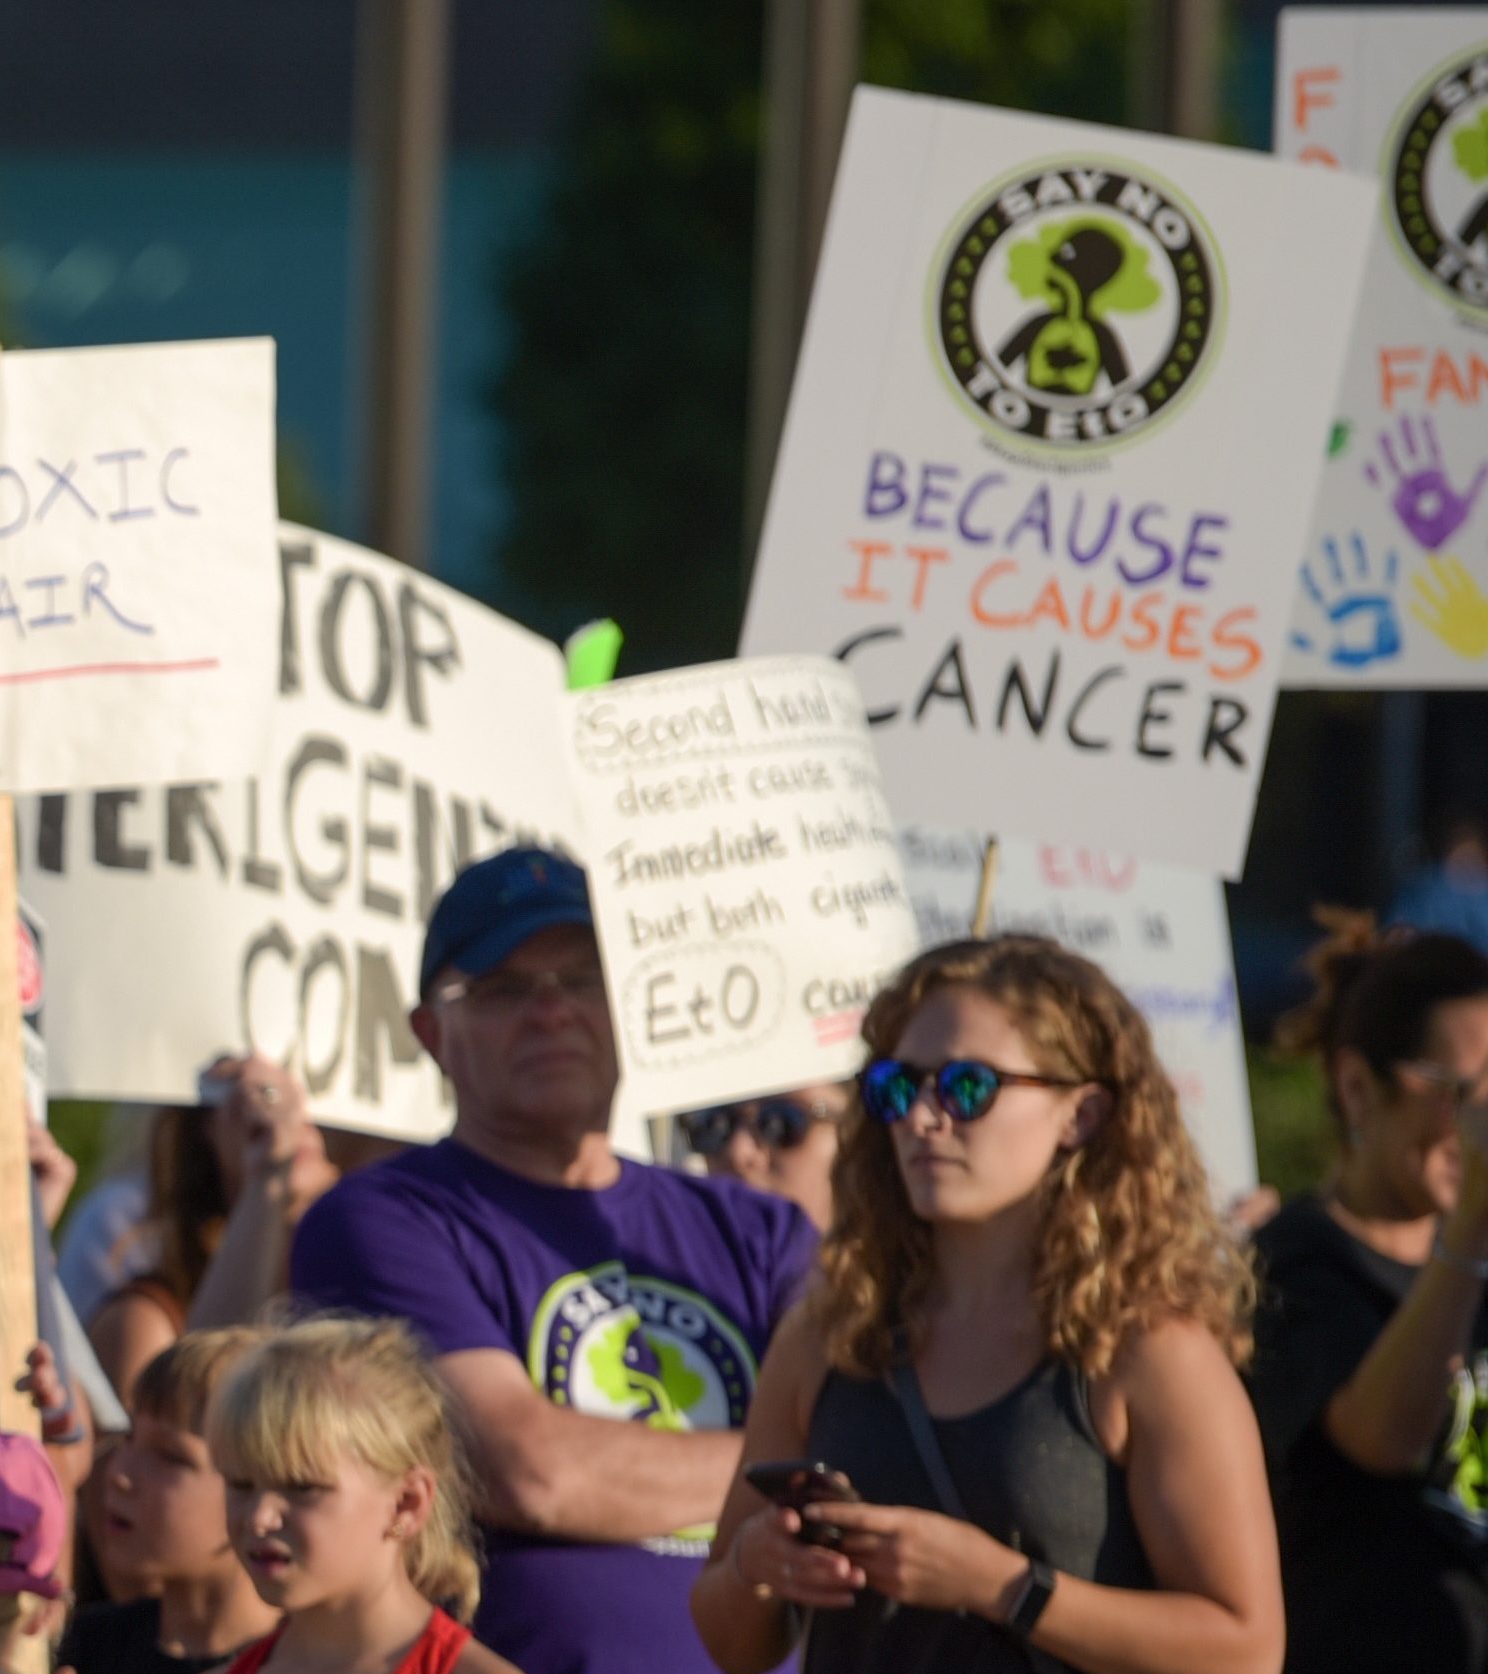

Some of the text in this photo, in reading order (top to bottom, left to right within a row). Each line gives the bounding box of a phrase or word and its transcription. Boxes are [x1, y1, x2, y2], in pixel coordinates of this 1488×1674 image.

[998, 167, 1191, 251] SAY NO
[967, 359, 1032, 430] TO
[861, 452, 1230, 591] BECAUSE
[841, 539, 1265, 684] IT CAUSES
[580, 677, 835, 754] Second hand
[606, 822, 789, 888] Immediate
[627, 905, 692, 948] but
[707, 890, 787, 942] both
[644, 962, 761, 1047] EtO
